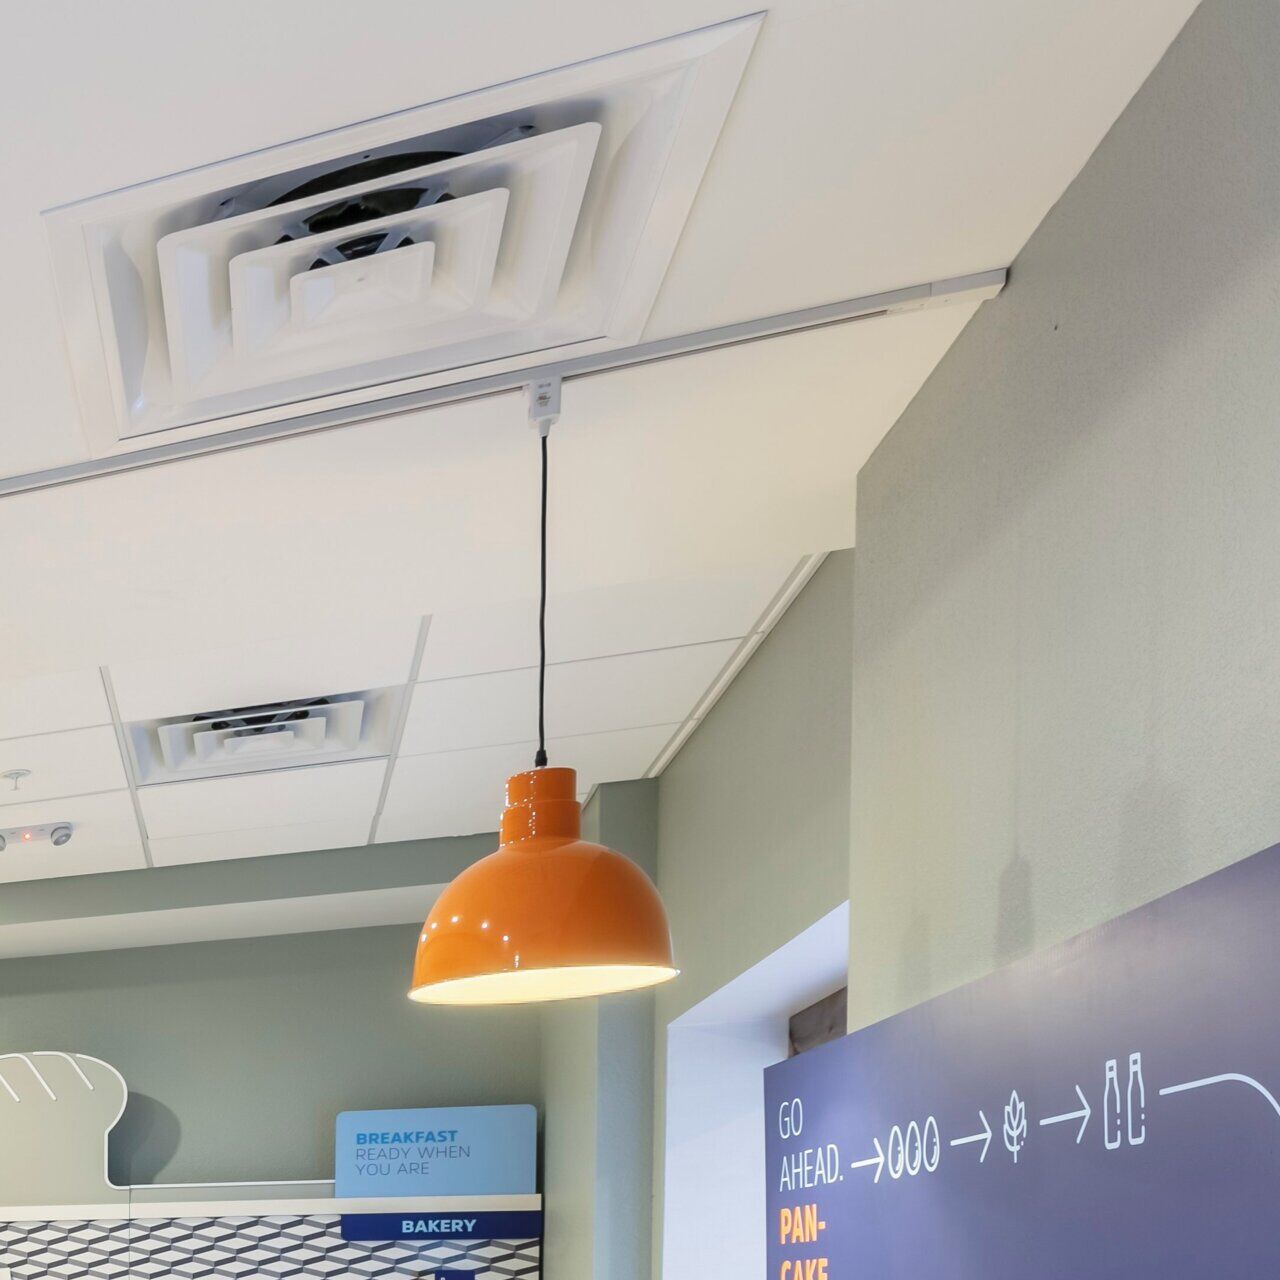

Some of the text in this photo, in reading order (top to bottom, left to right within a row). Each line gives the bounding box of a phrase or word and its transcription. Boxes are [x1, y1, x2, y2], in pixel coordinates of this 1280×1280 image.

[779, 1098, 803, 1139] GO
[356, 1130, 458, 1145] BREAKFAST
[356, 1145, 471, 1161] READY WHEN
[355, 1161, 429, 1176] YOU ARE
[779, 1144, 843, 1192] AHEAD.
[402, 1218, 476, 1233] BAKERY
[780, 1203, 826, 1245] PAN-
